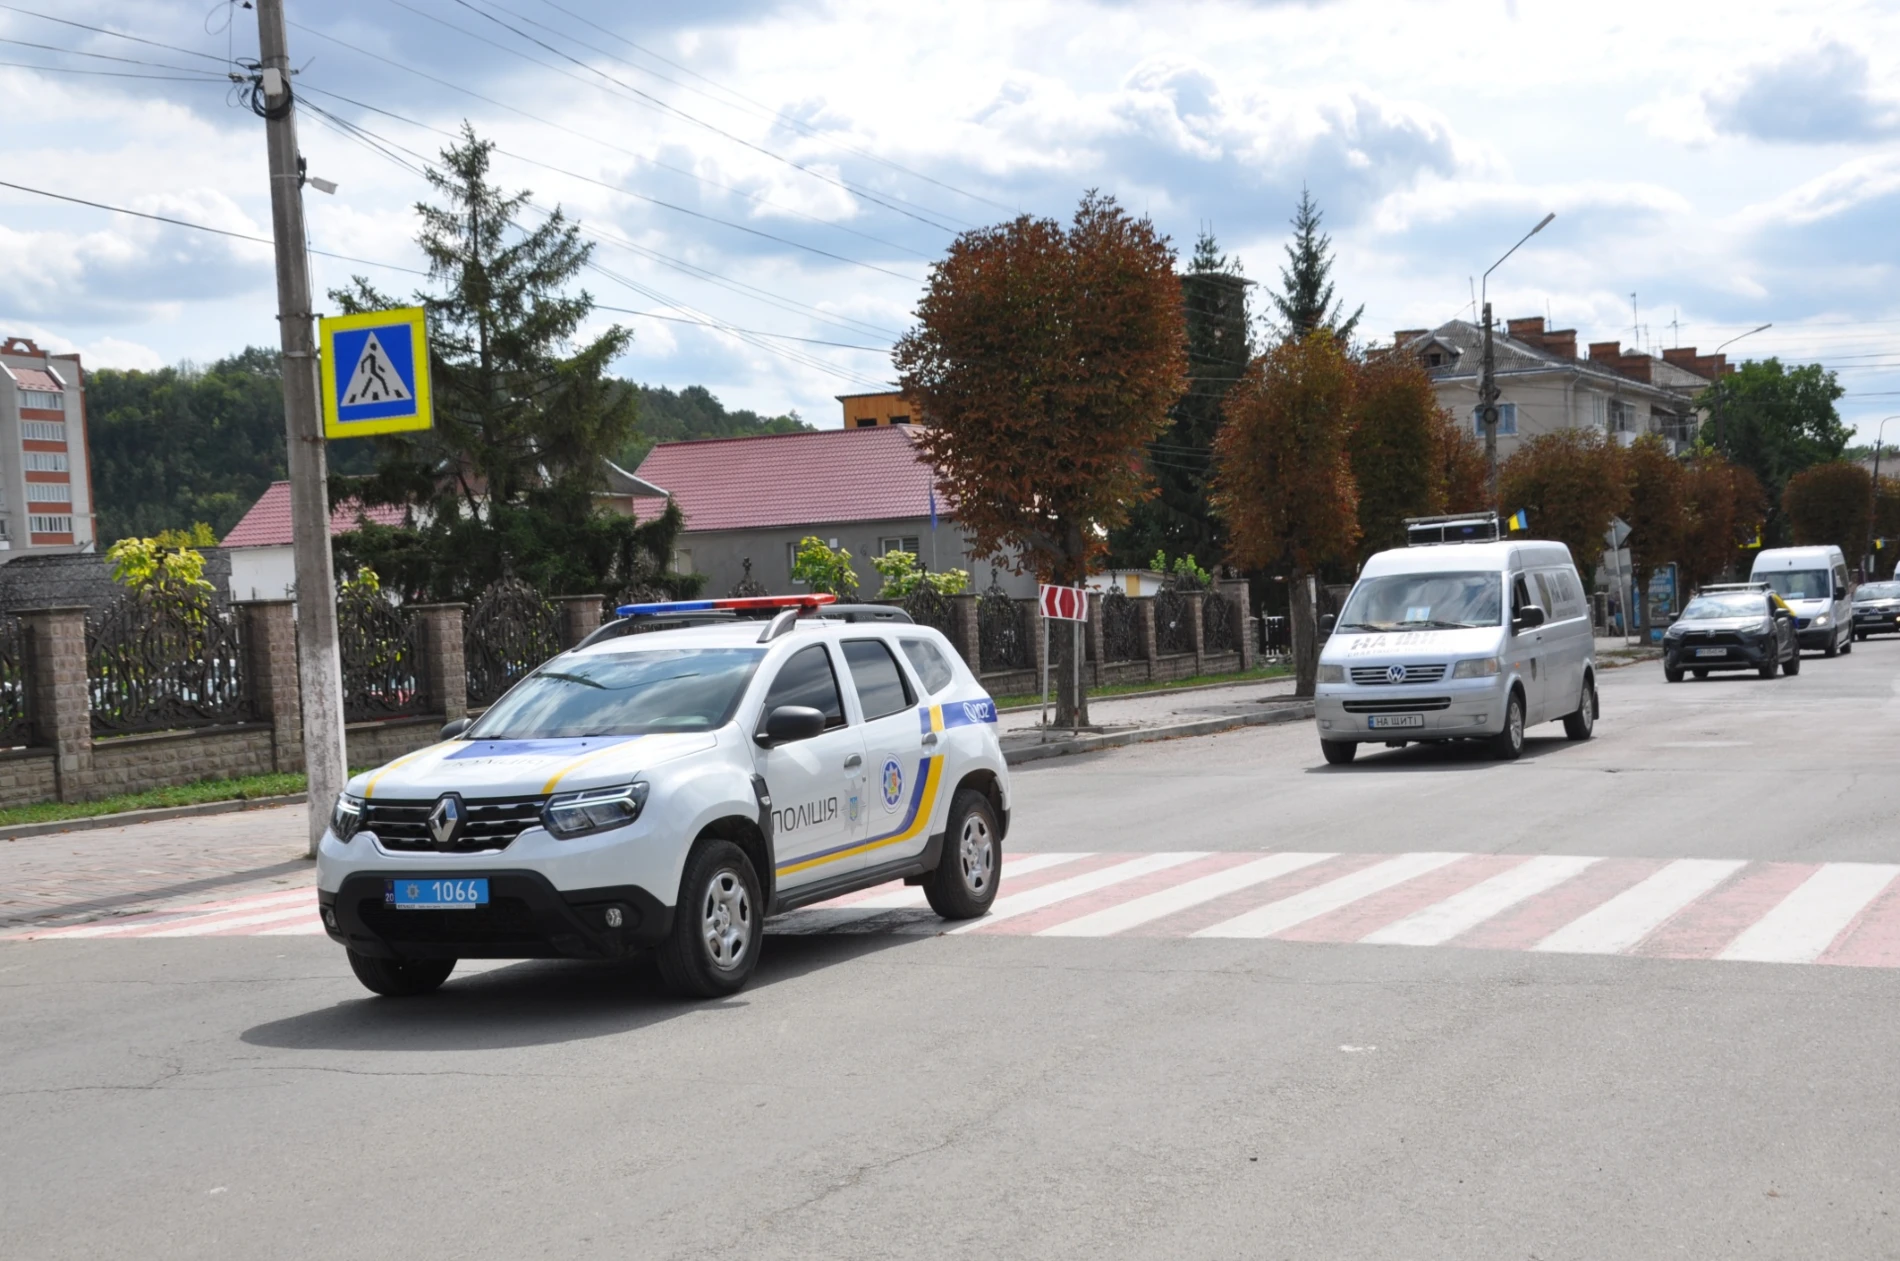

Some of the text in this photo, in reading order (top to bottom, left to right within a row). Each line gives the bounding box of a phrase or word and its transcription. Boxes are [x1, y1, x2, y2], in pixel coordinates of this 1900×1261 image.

[1376, 716, 1417, 726] НА ЩИТІ
[772, 797, 838, 833] ПОЛІЦІЯ
[385, 893, 394, 902] 20
[432, 881, 478, 901] 1066
